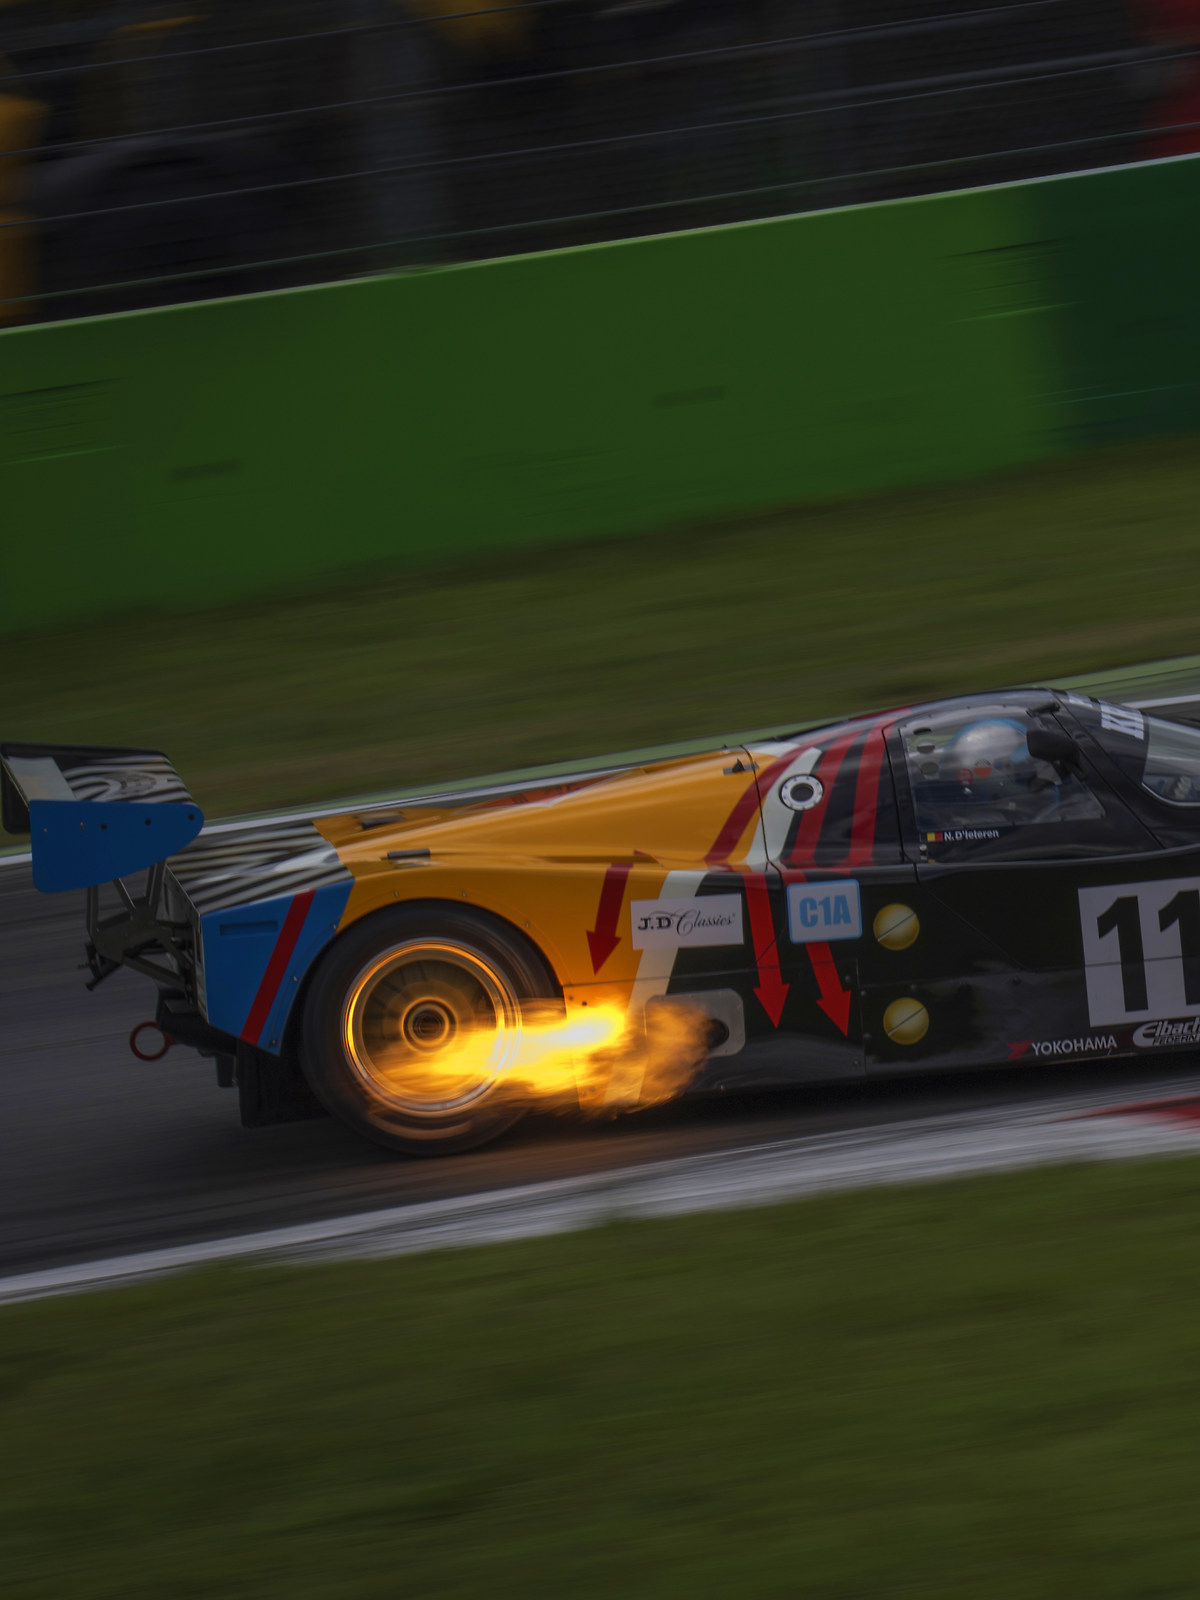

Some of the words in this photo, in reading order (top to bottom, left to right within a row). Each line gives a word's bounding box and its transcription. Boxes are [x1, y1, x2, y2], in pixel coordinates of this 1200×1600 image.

[666, 908, 733, 938] Classics
[799, 895, 852, 928] C1A
[1031, 1034, 1119, 1057] YOKOHAMA
